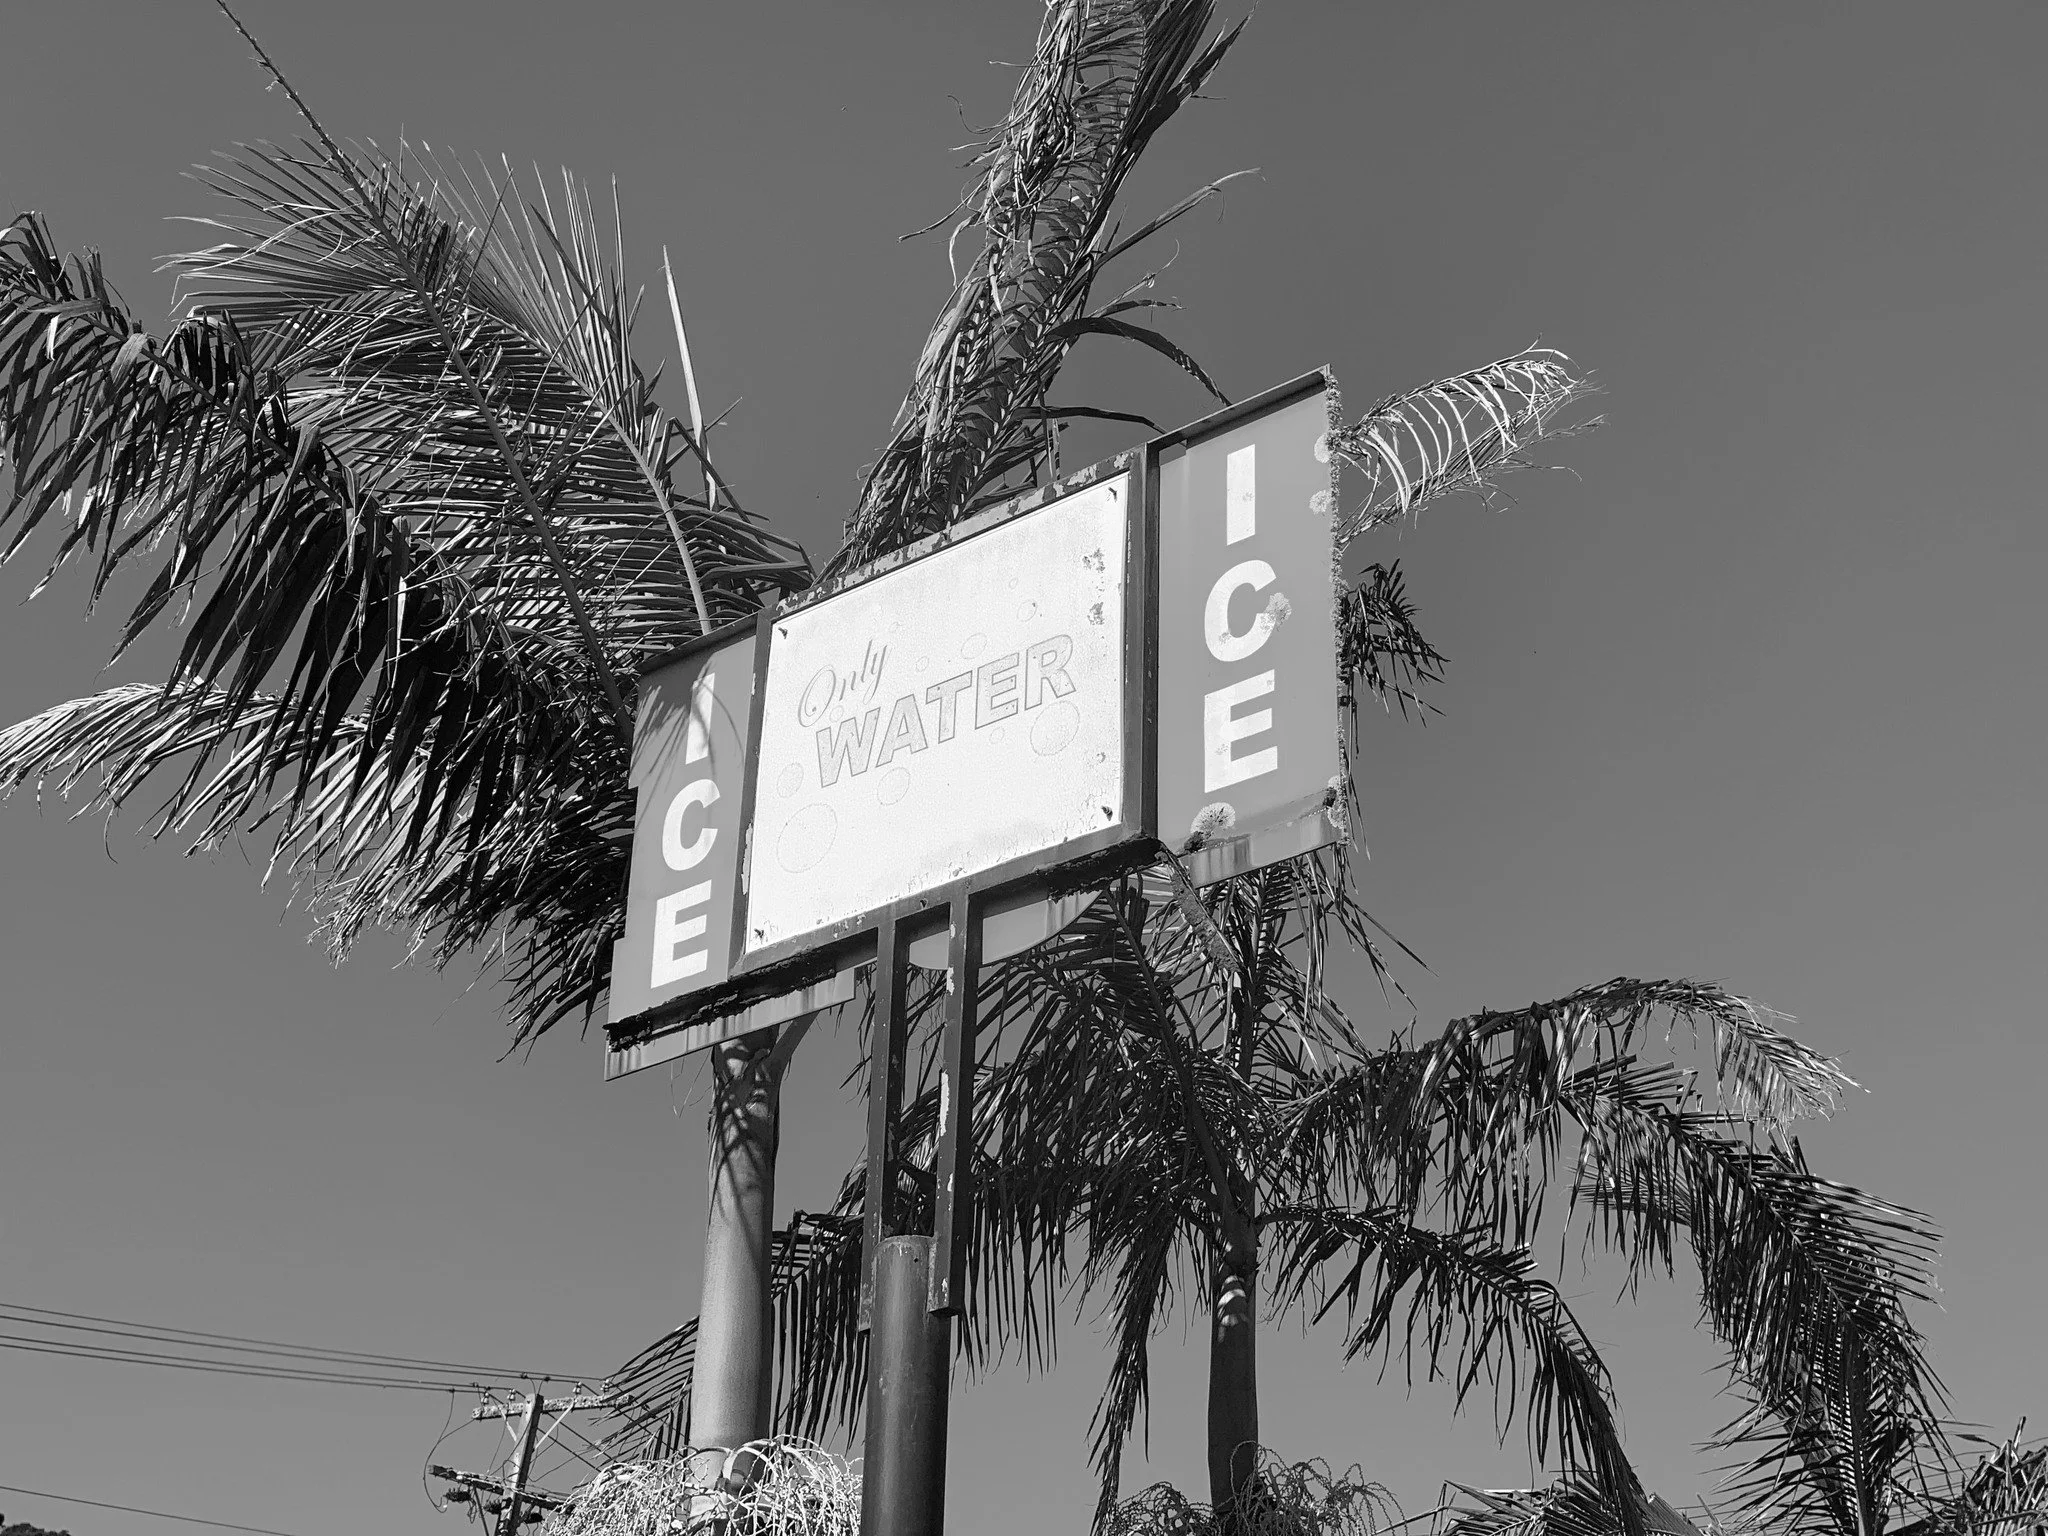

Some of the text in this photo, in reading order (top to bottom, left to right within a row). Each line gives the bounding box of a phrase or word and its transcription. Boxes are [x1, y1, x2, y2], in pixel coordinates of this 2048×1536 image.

[798, 639, 888, 727] Only
[816, 634, 1076, 788] WATER
[1204, 444, 1278, 793] ICE
[651, 672, 720, 989] ICE
